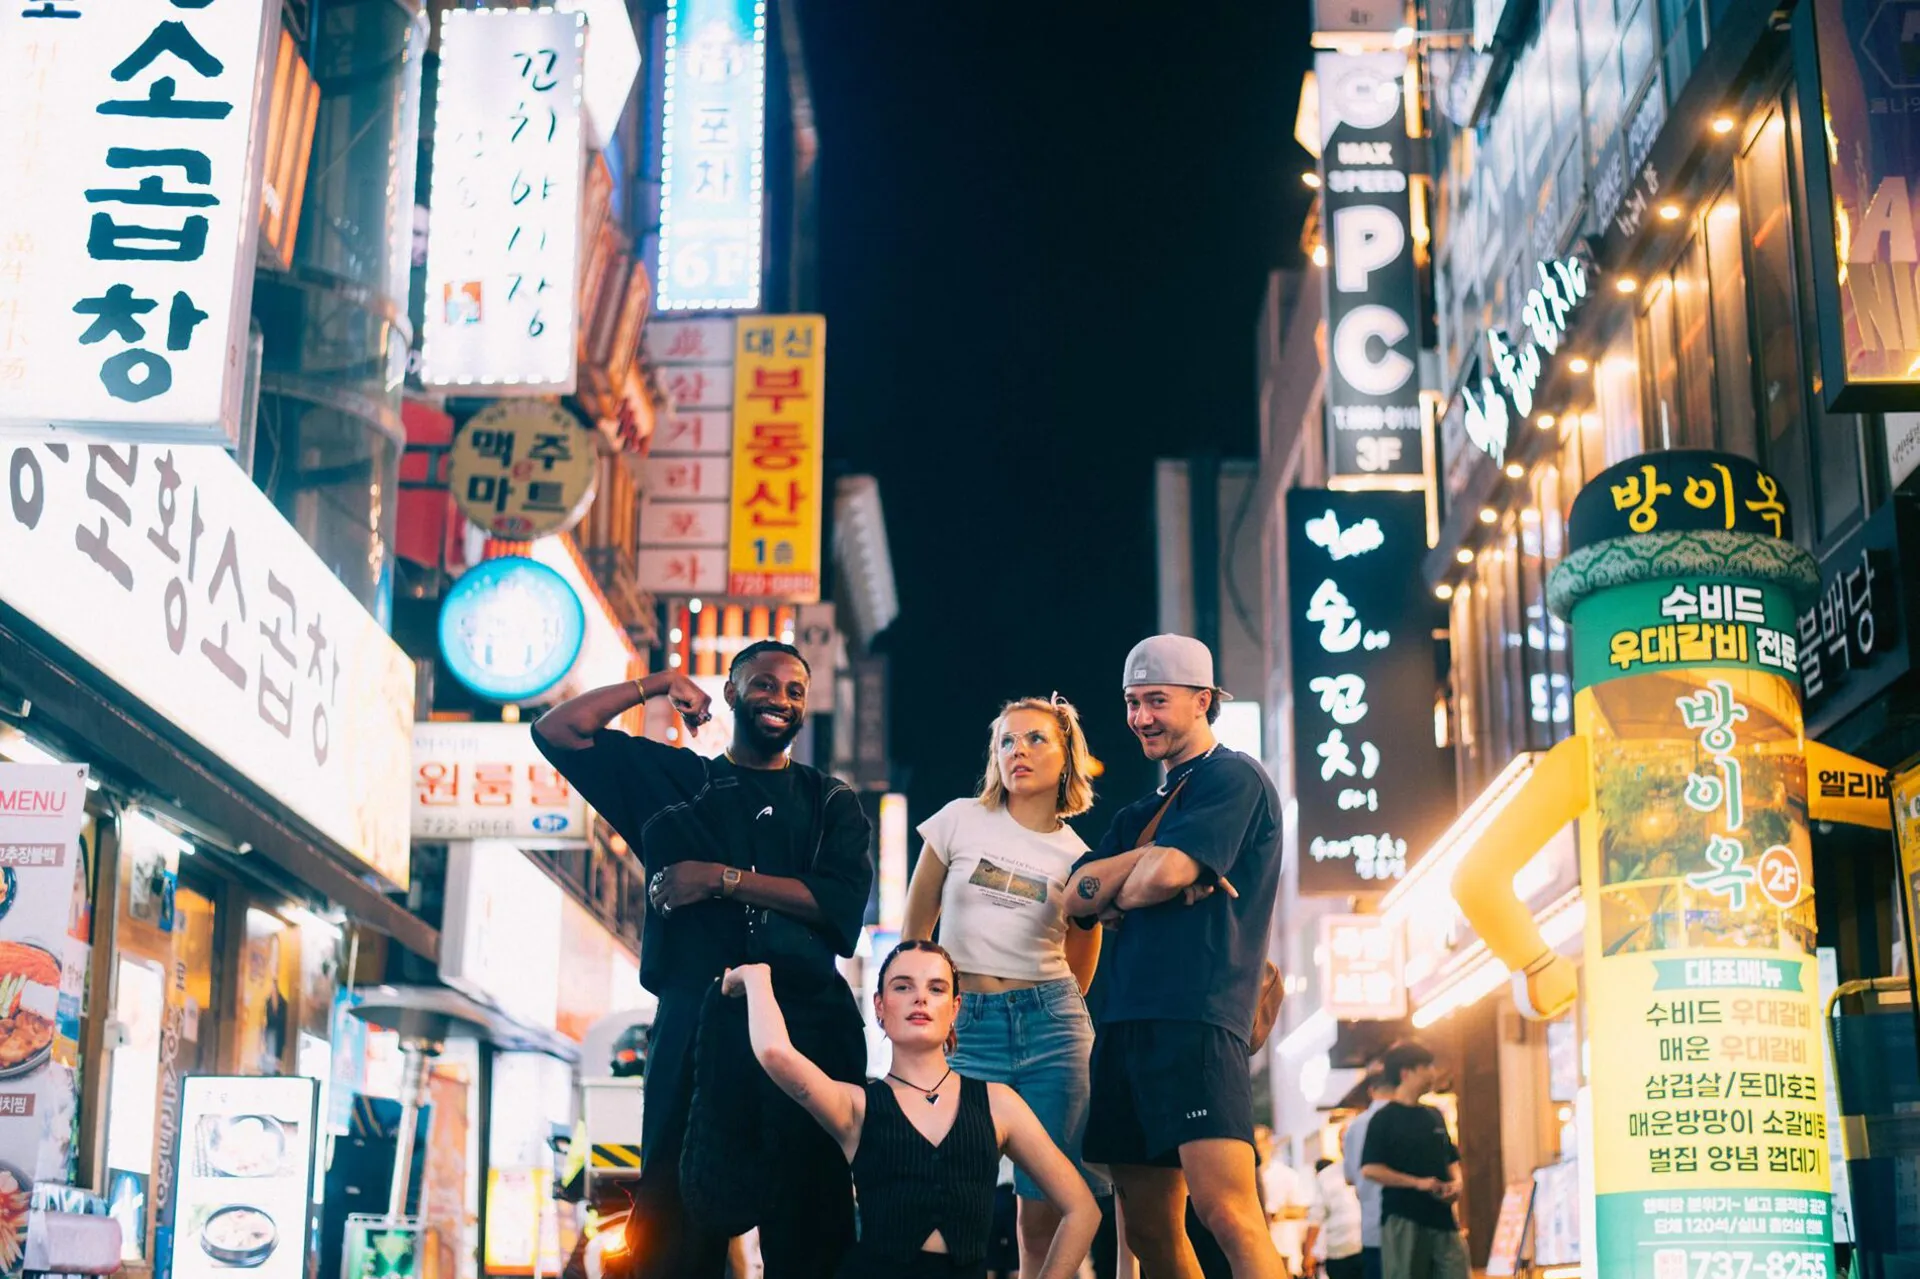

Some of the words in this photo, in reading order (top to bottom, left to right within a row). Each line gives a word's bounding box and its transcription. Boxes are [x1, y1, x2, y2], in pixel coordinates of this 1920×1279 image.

[72, 0, 234, 402] 소곱창
[471, 428, 573, 471] 맥주
[741, 366, 811, 528] 부동산
[467, 473, 567, 514] 마트
[1609, 462, 1786, 539] 방이옥
[1661, 584, 1765, 624] 수비드
[1609, 623, 1749, 670] 우대갈비
[1755, 627, 1798, 673] 전문
[0, 789, 67, 812] MENU
[1676, 679, 1756, 912] 방이옥
[1765, 859, 1796, 892] 2F
[1684, 959, 1783, 988] 대표메뉴
[1646, 1000, 1723, 1027] 수비드
[1730, 998, 1812, 1029] 우대갈비
[1659, 1035, 1711, 1062] 매운
[1719, 1035, 1808, 1065] 우대갈비
[1629, 1109, 1754, 1137] 매운방망이
[1649, 1146, 1698, 1173] 벌집
[1707, 1145, 1760, 1172] 양념
[1767, 1146, 1822, 1176] 껍데기
[1690, 1251, 1828, 1279] 737-8255
